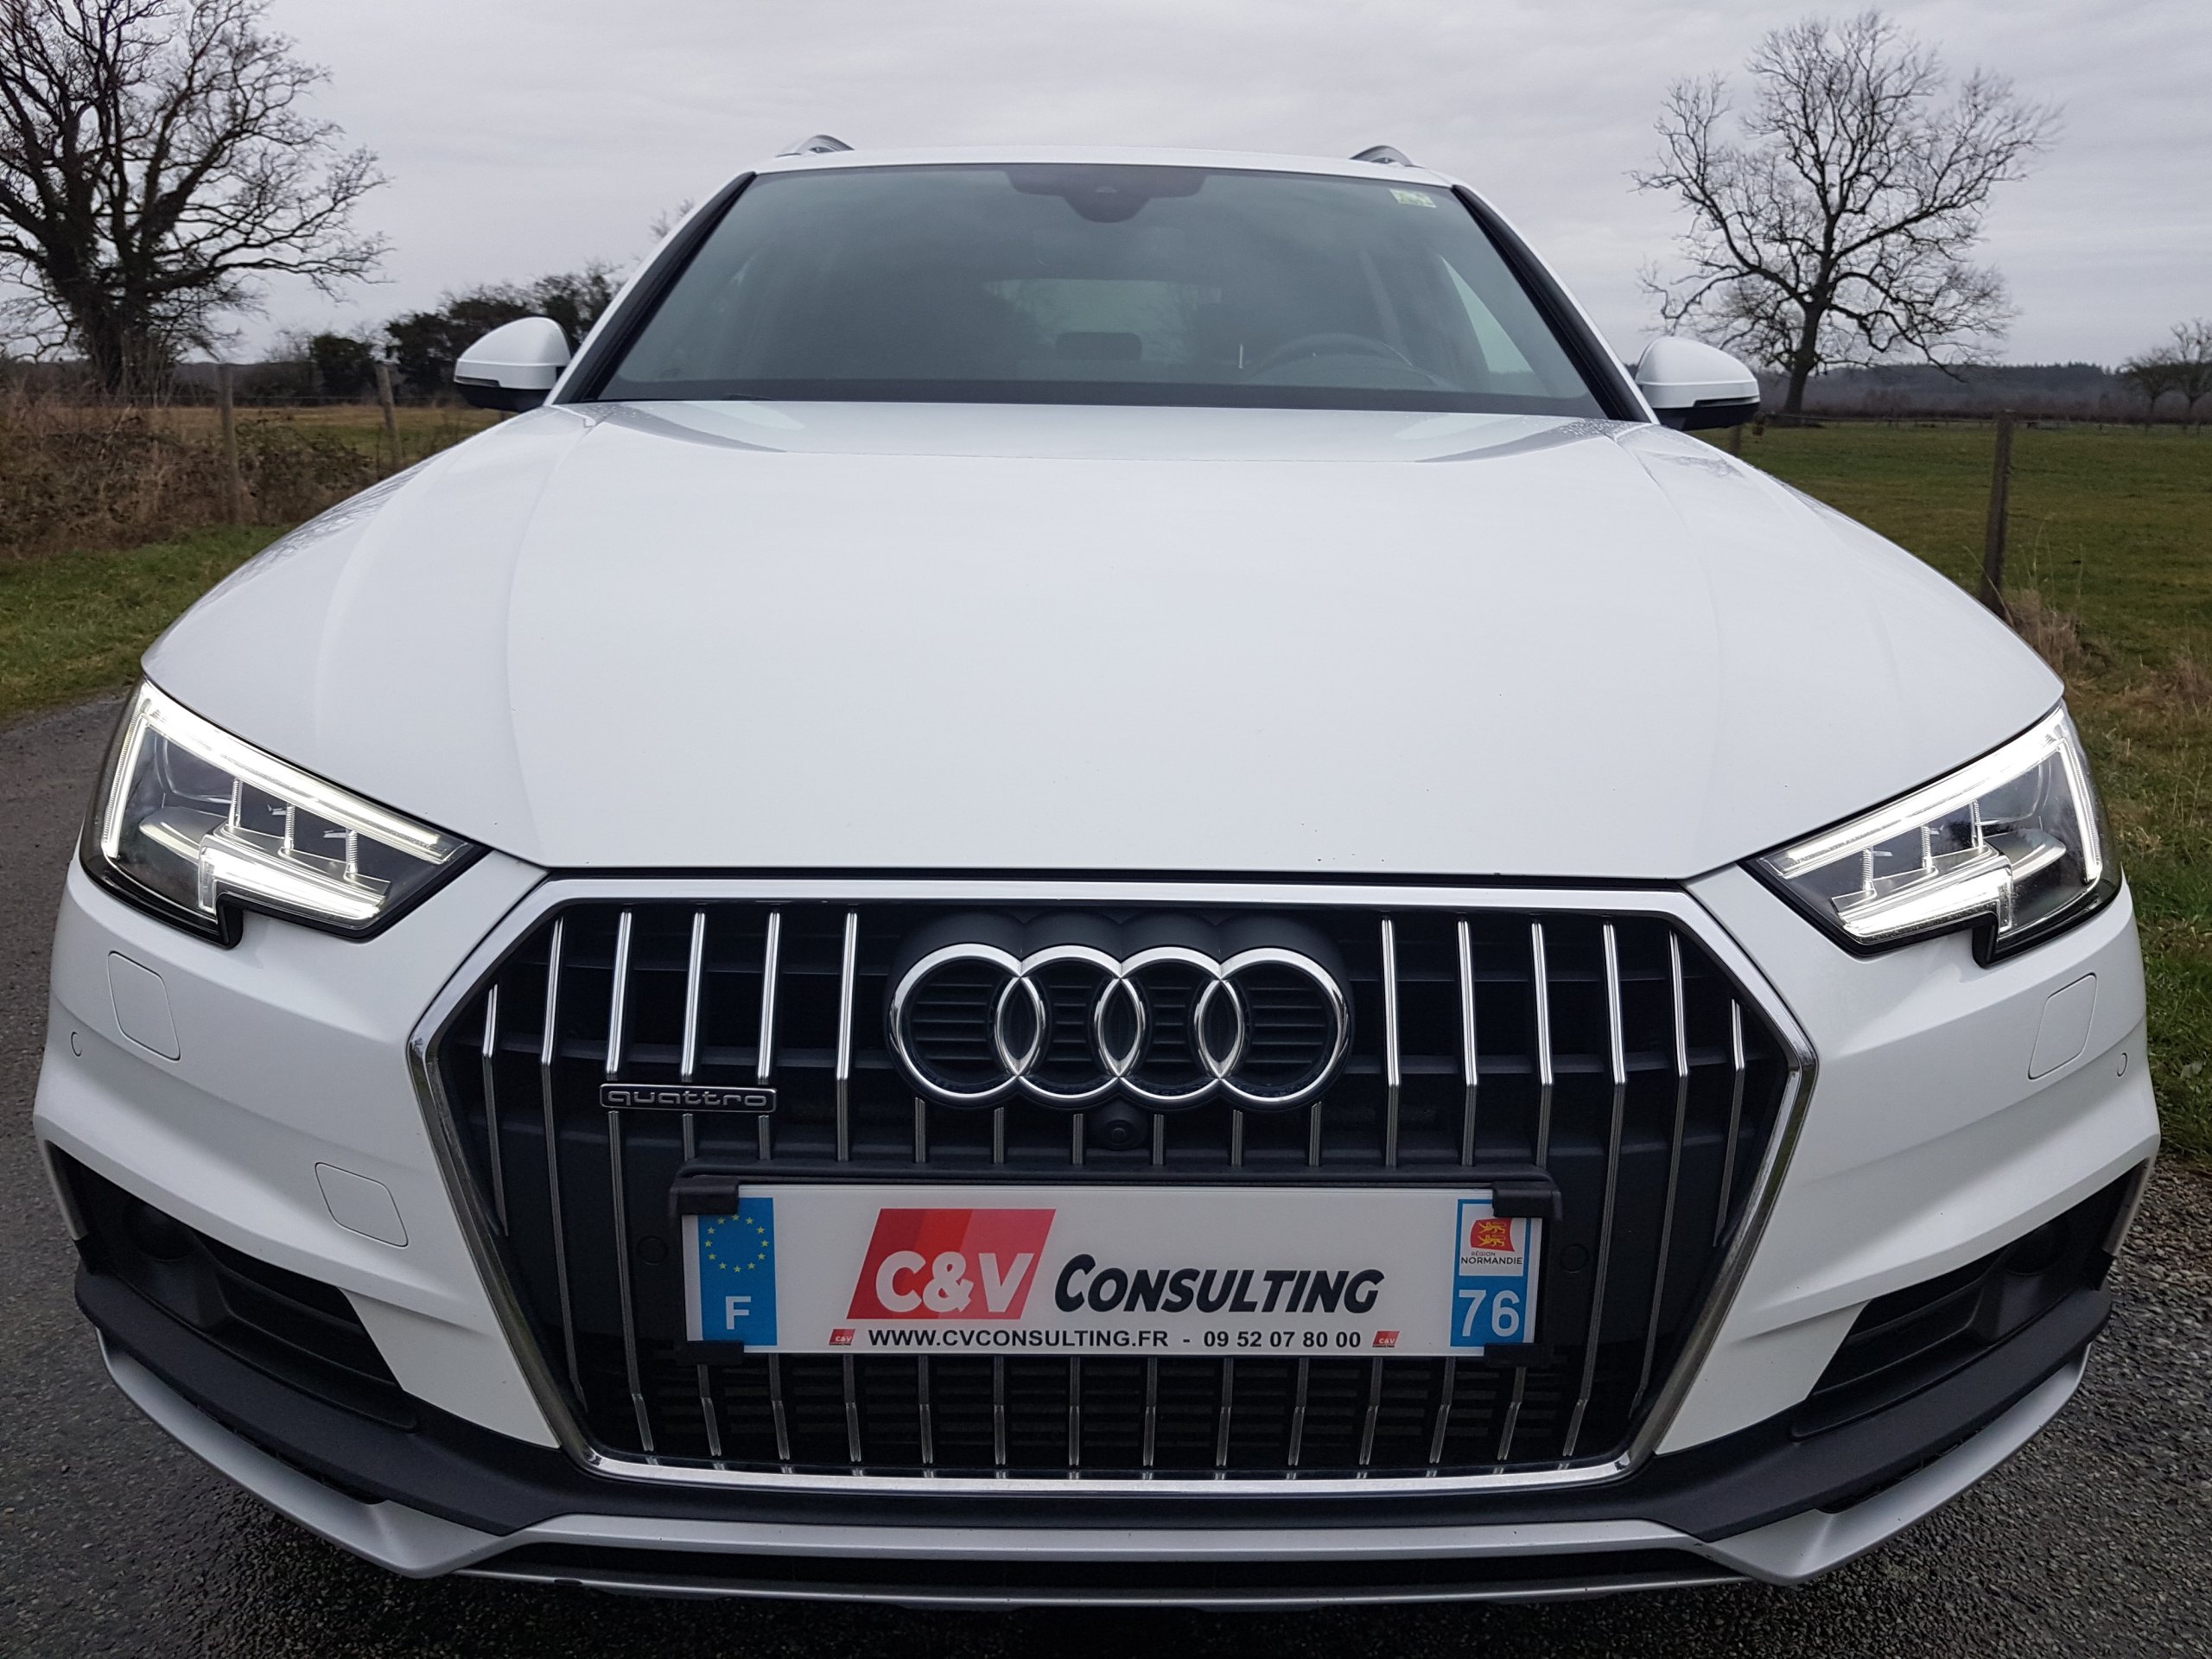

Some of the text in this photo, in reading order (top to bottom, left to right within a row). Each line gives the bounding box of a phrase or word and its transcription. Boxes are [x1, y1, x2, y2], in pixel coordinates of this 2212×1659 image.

[607, 1090, 767, 1107] quattro
[1461, 1256, 1522, 1265] NORMANDIE
[875, 1250, 1384, 1313] C&V CONSULTING
[725, 1296, 751, 1329] F
[1459, 1289, 1520, 1338] 76
[868, 1330, 1168, 1347] WWW.CVCONSULTING.FR
[1204, 1331, 1229, 1347] 09
[1236, 1331, 1262, 1347] 52
[1269, 1331, 1295, 1347] 07
[1302, 1331, 1328, 1347] 80
[1335, 1332, 1361, 1348] 00
